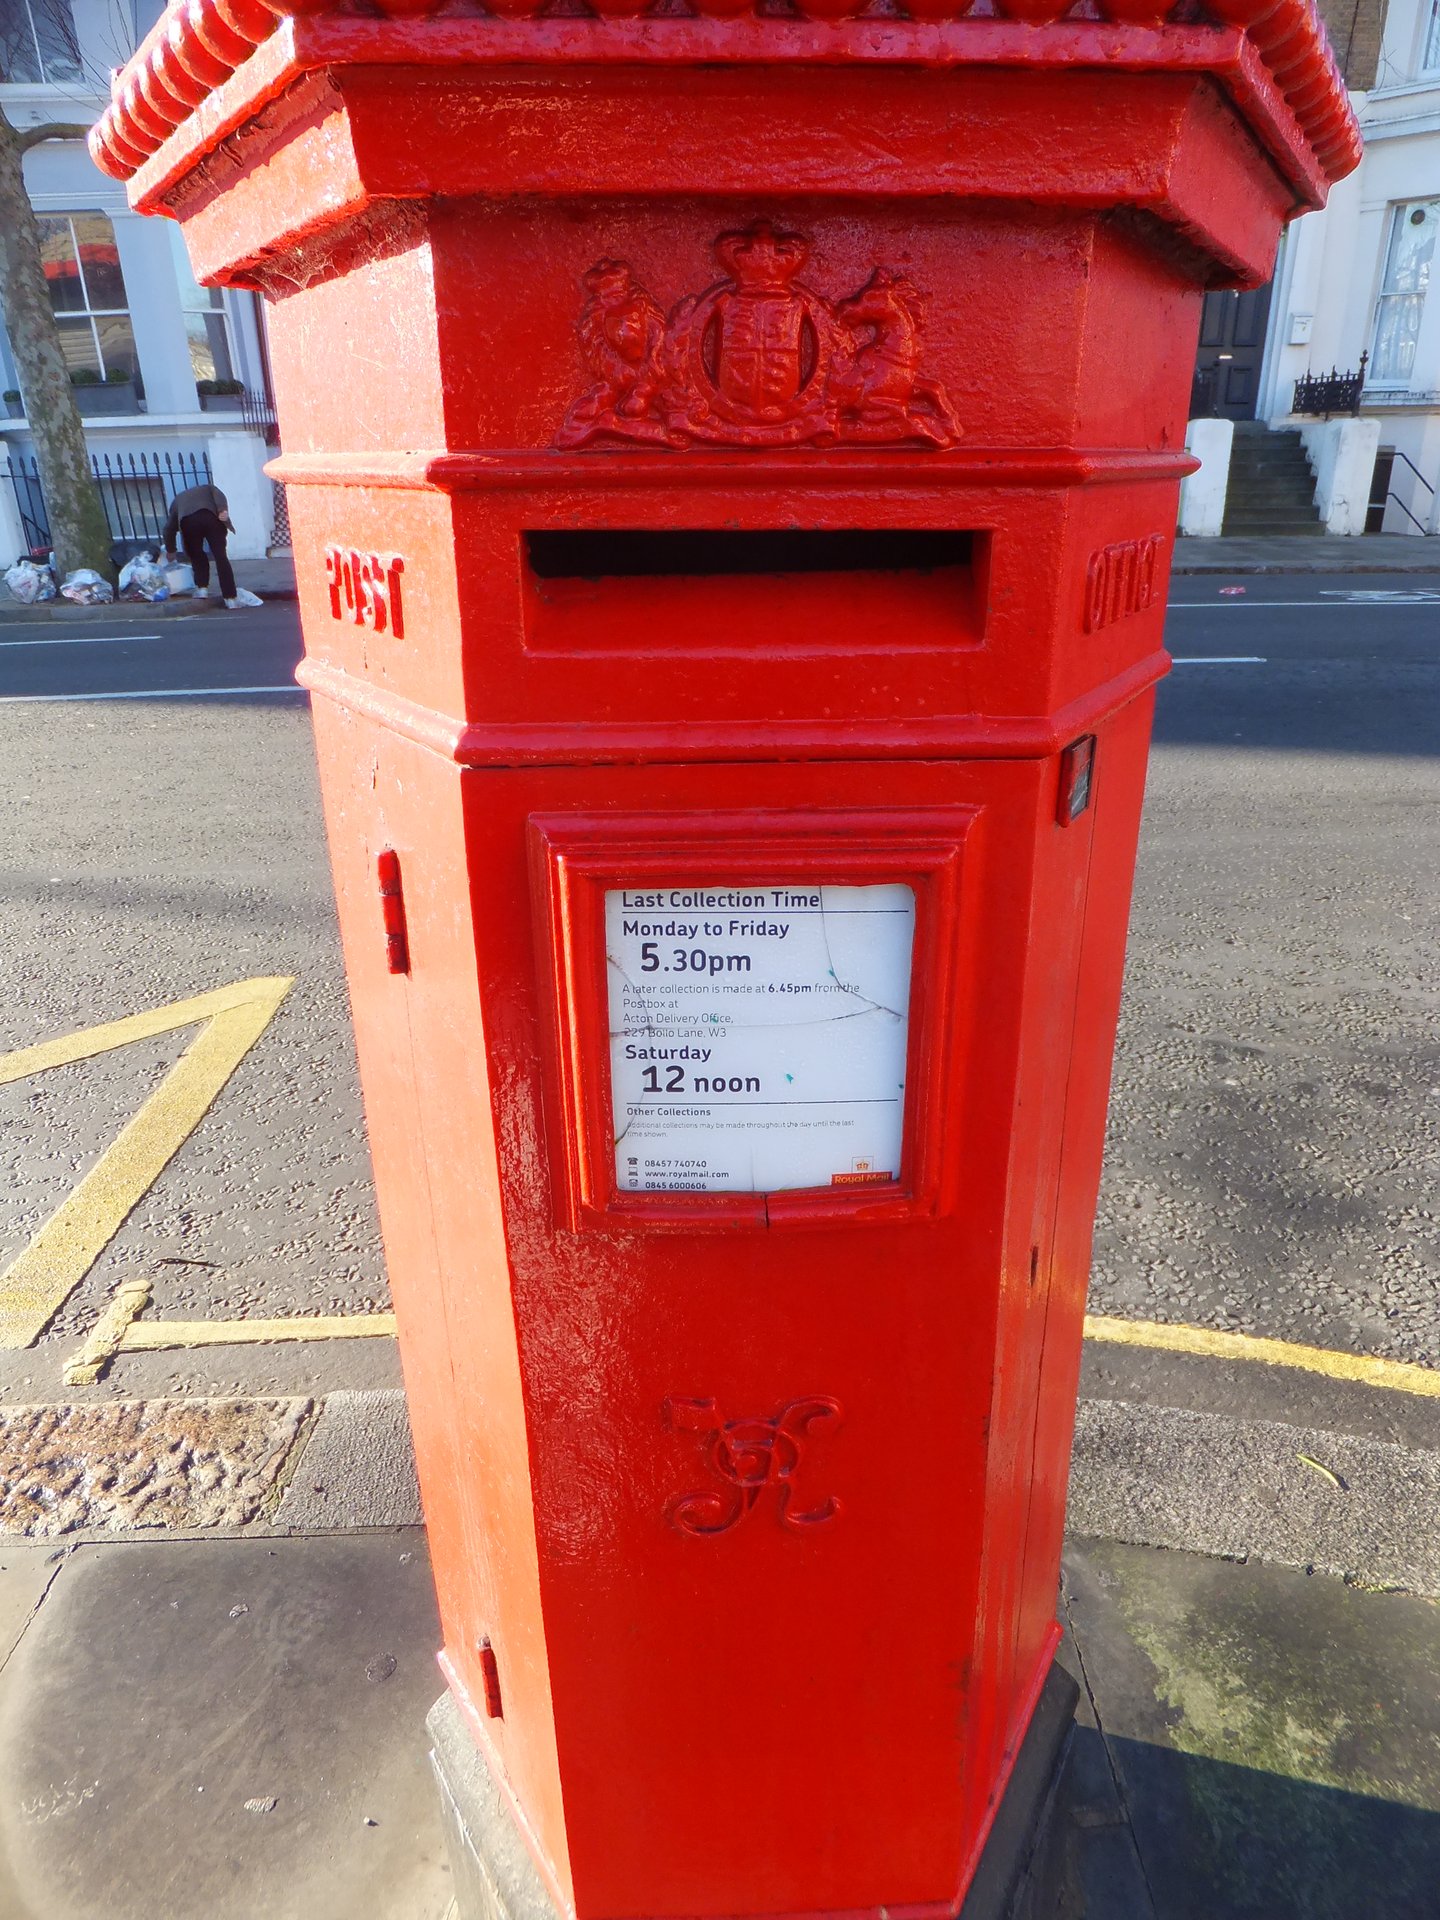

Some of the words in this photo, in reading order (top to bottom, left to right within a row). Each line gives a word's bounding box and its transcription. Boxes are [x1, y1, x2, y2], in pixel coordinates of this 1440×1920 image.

[324, 543, 405, 640] POST
[622, 891, 664, 908] Last
[670, 891, 765, 908] Collection
[771, 891, 819, 908] Time
[623, 920, 699, 940] Monday
[704, 922, 722, 936] to
[729, 920, 790, 940] Friday
[641, 942, 751, 977] 5.30pm
[622, 984, 630, 993] A
[633, 984, 656, 993] later
[660, 984, 709, 993] collection
[712, 984, 719, 993] is
[723, 984, 752, 993] made
[755, 984, 765, 993] at
[768, 983, 812, 994] 6.45pm
[814, 983, 840, 993] from
[842, 983, 860, 993] the
[623, 998, 666, 1009] Postbox
[668, 999, 679, 1009] at
[623, 1013, 653, 1023] Acton
[656, 1013, 699, 1025] Delivery
[701, 1013, 734, 1024] Office,
[624, 1028, 645, 1037] 229
[678, 1028, 706, 1038] Lane,
[709, 1027, 727, 1038] W3
[625, 1044, 712, 1063] Saturday
[641, 1065, 685, 1093] 12
[693, 1077, 761, 1093] noon
[626, 1107, 655, 1116] Other
[657, 1107, 711, 1116] Collections
[662, 1121, 698, 1129] collections
[700, 1122, 714, 1130] may
[715, 1121, 724, 1129] be
[725, 1121, 745, 1129] made
[812, 1119, 828, 1127] until
[829, 1118, 841, 1126] the
[842, 1118, 854, 1126] last
[626, 1130, 642, 1138] time
[644, 1160, 672, 1168] 08457
[674, 1160, 707, 1168] 740740
[644, 1170, 729, 1179] www.royalmail.com
[834, 1174, 864, 1184] Royal
[866, 1172, 889, 1182] Mail
[645, 1181, 667, 1189] 0845
[669, 1182, 707, 1190] 6000606
